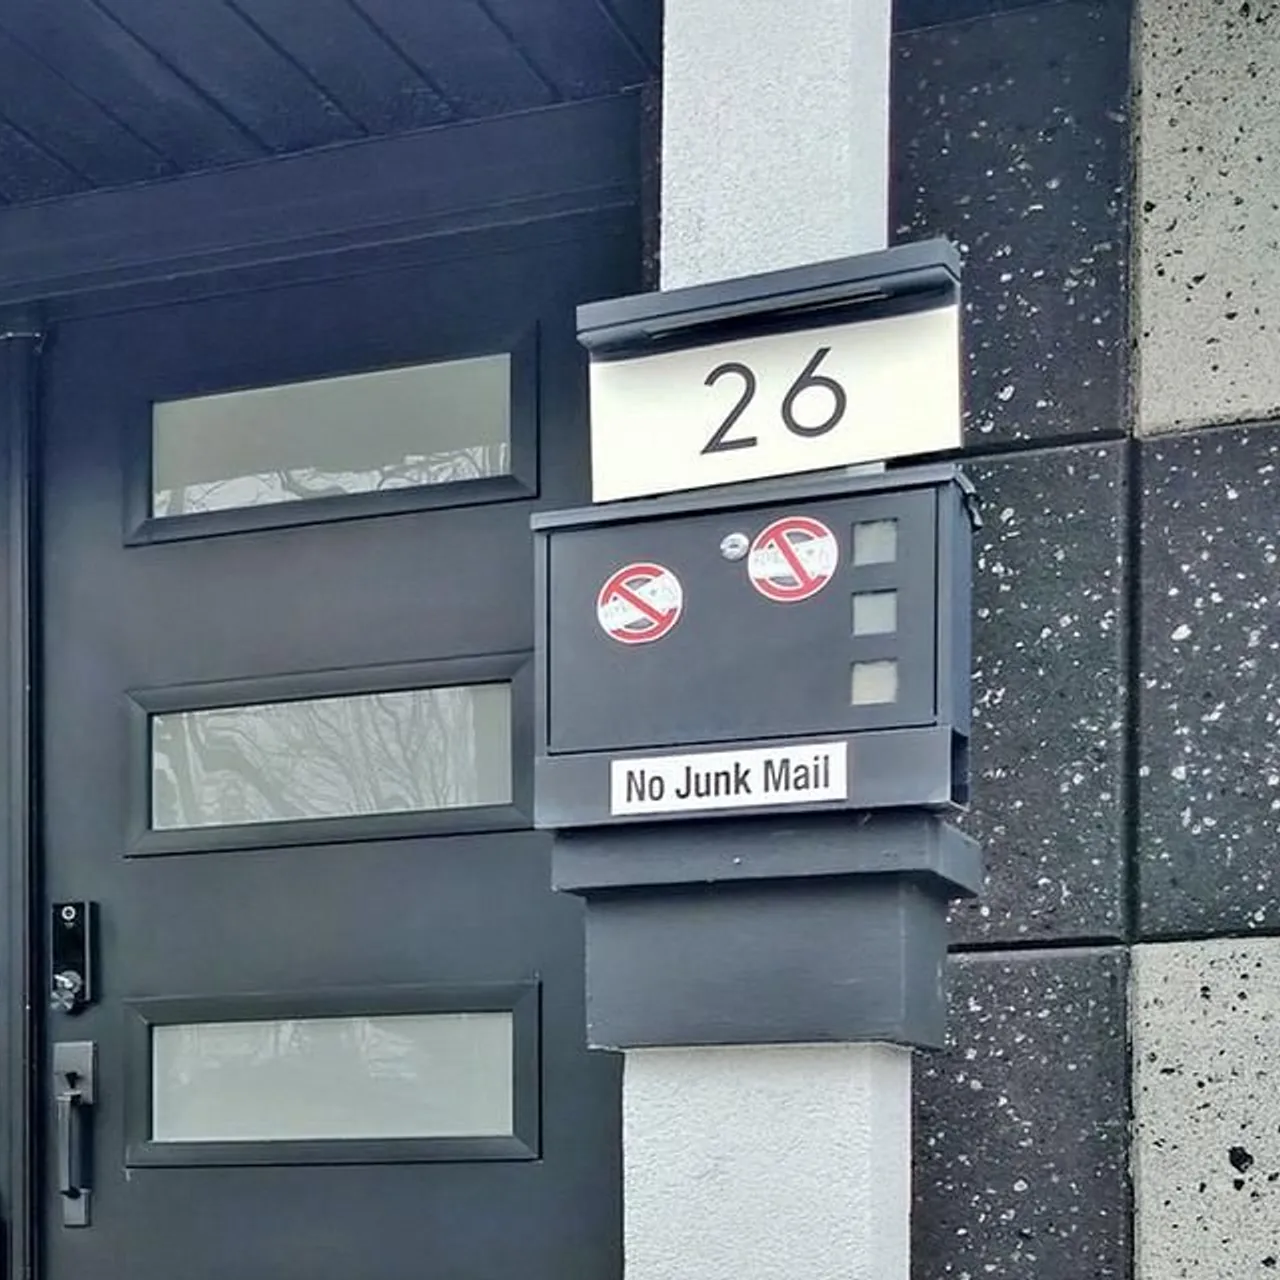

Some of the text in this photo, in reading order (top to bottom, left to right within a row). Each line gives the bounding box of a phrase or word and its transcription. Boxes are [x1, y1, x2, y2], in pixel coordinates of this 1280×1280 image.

[700, 346, 847, 455] 26
[627, 757, 830, 803] No Junk Mail
